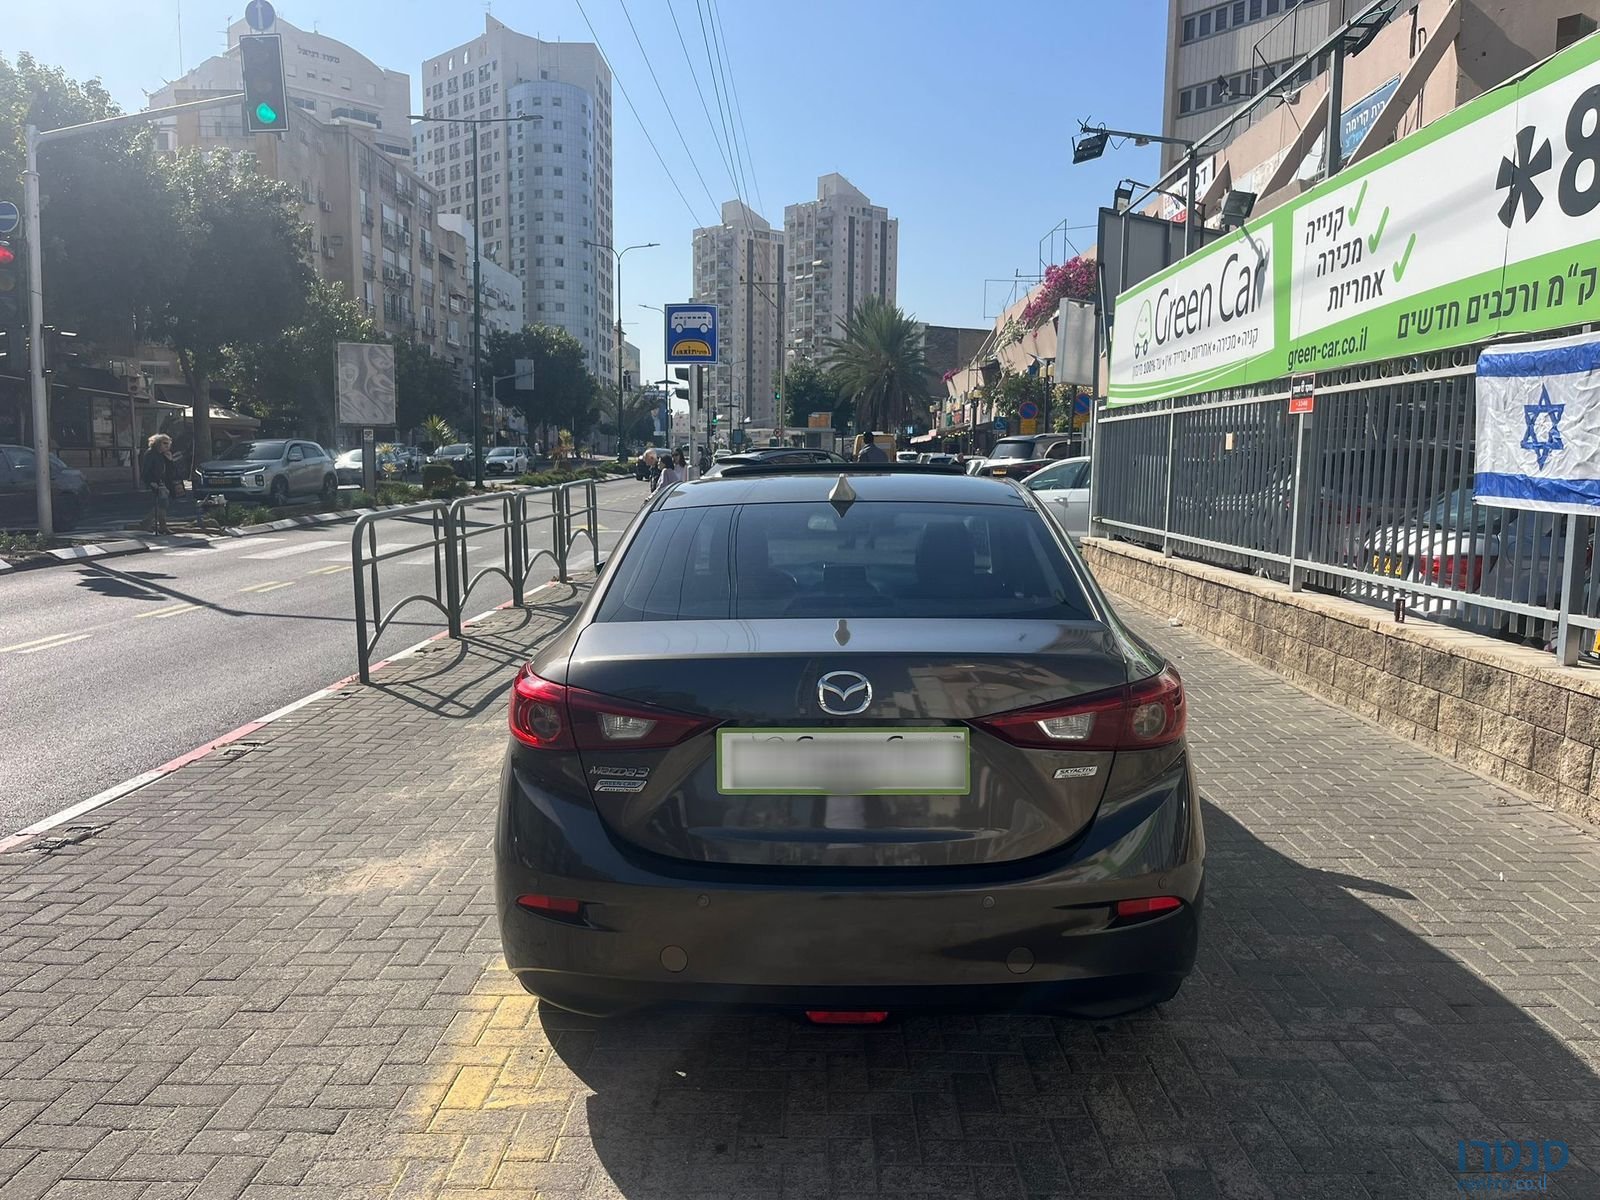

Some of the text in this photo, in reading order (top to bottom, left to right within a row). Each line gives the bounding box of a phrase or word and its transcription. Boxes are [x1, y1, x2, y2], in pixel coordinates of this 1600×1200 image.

[1345, 110, 1369, 134] קדימה
[1306, 206, 1345, 245] קנייה
[1317, 237, 1363, 278] מכירה
[1155, 253, 1264, 345] Green Car
[1327, 269, 1386, 312] אחריות
[1466, 280, 1540, 325] ורכבים
[1397, 300, 1461, 339] חדשים
[1287, 326, 1368, 371] green-car.co.il
